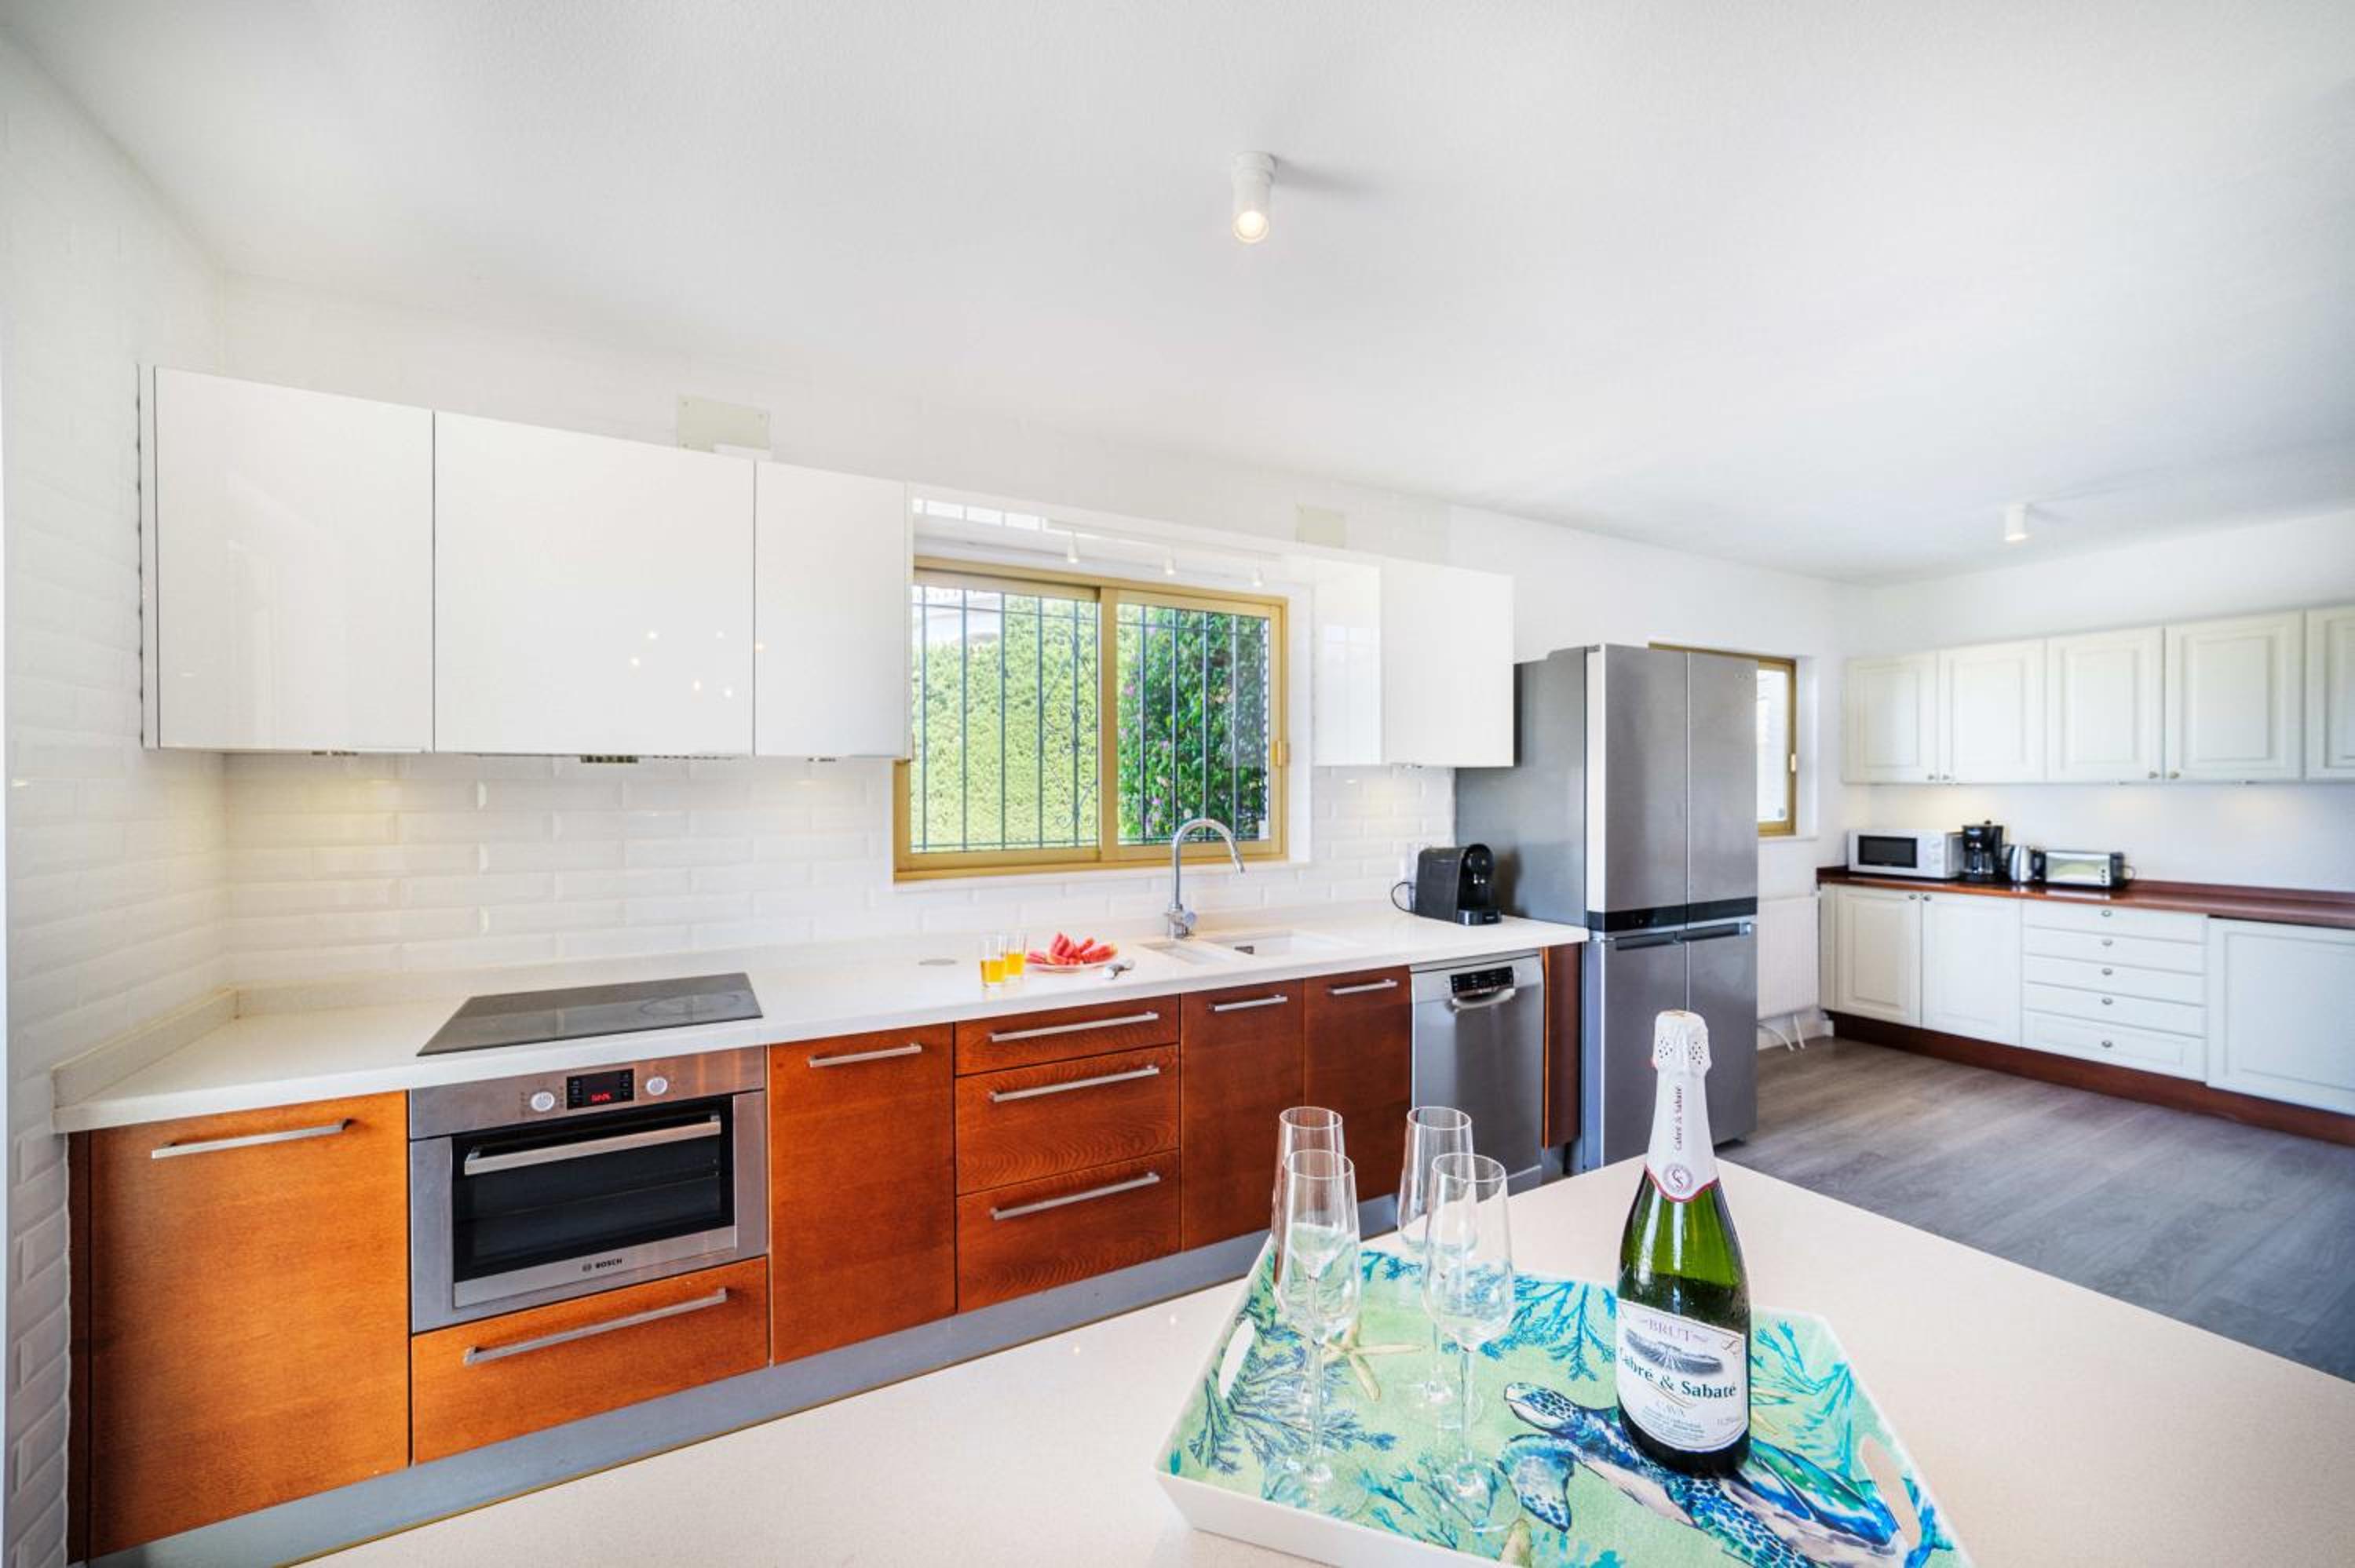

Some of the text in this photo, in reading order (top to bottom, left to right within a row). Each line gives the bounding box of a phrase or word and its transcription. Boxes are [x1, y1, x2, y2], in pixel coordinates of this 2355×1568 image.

[595, 1257, 623, 1269] BOSCH
[1648, 1317, 1690, 1341] BRUT
[1659, 1376, 1674, 1391] &
[1681, 1380, 1736, 1399] Sabaté
